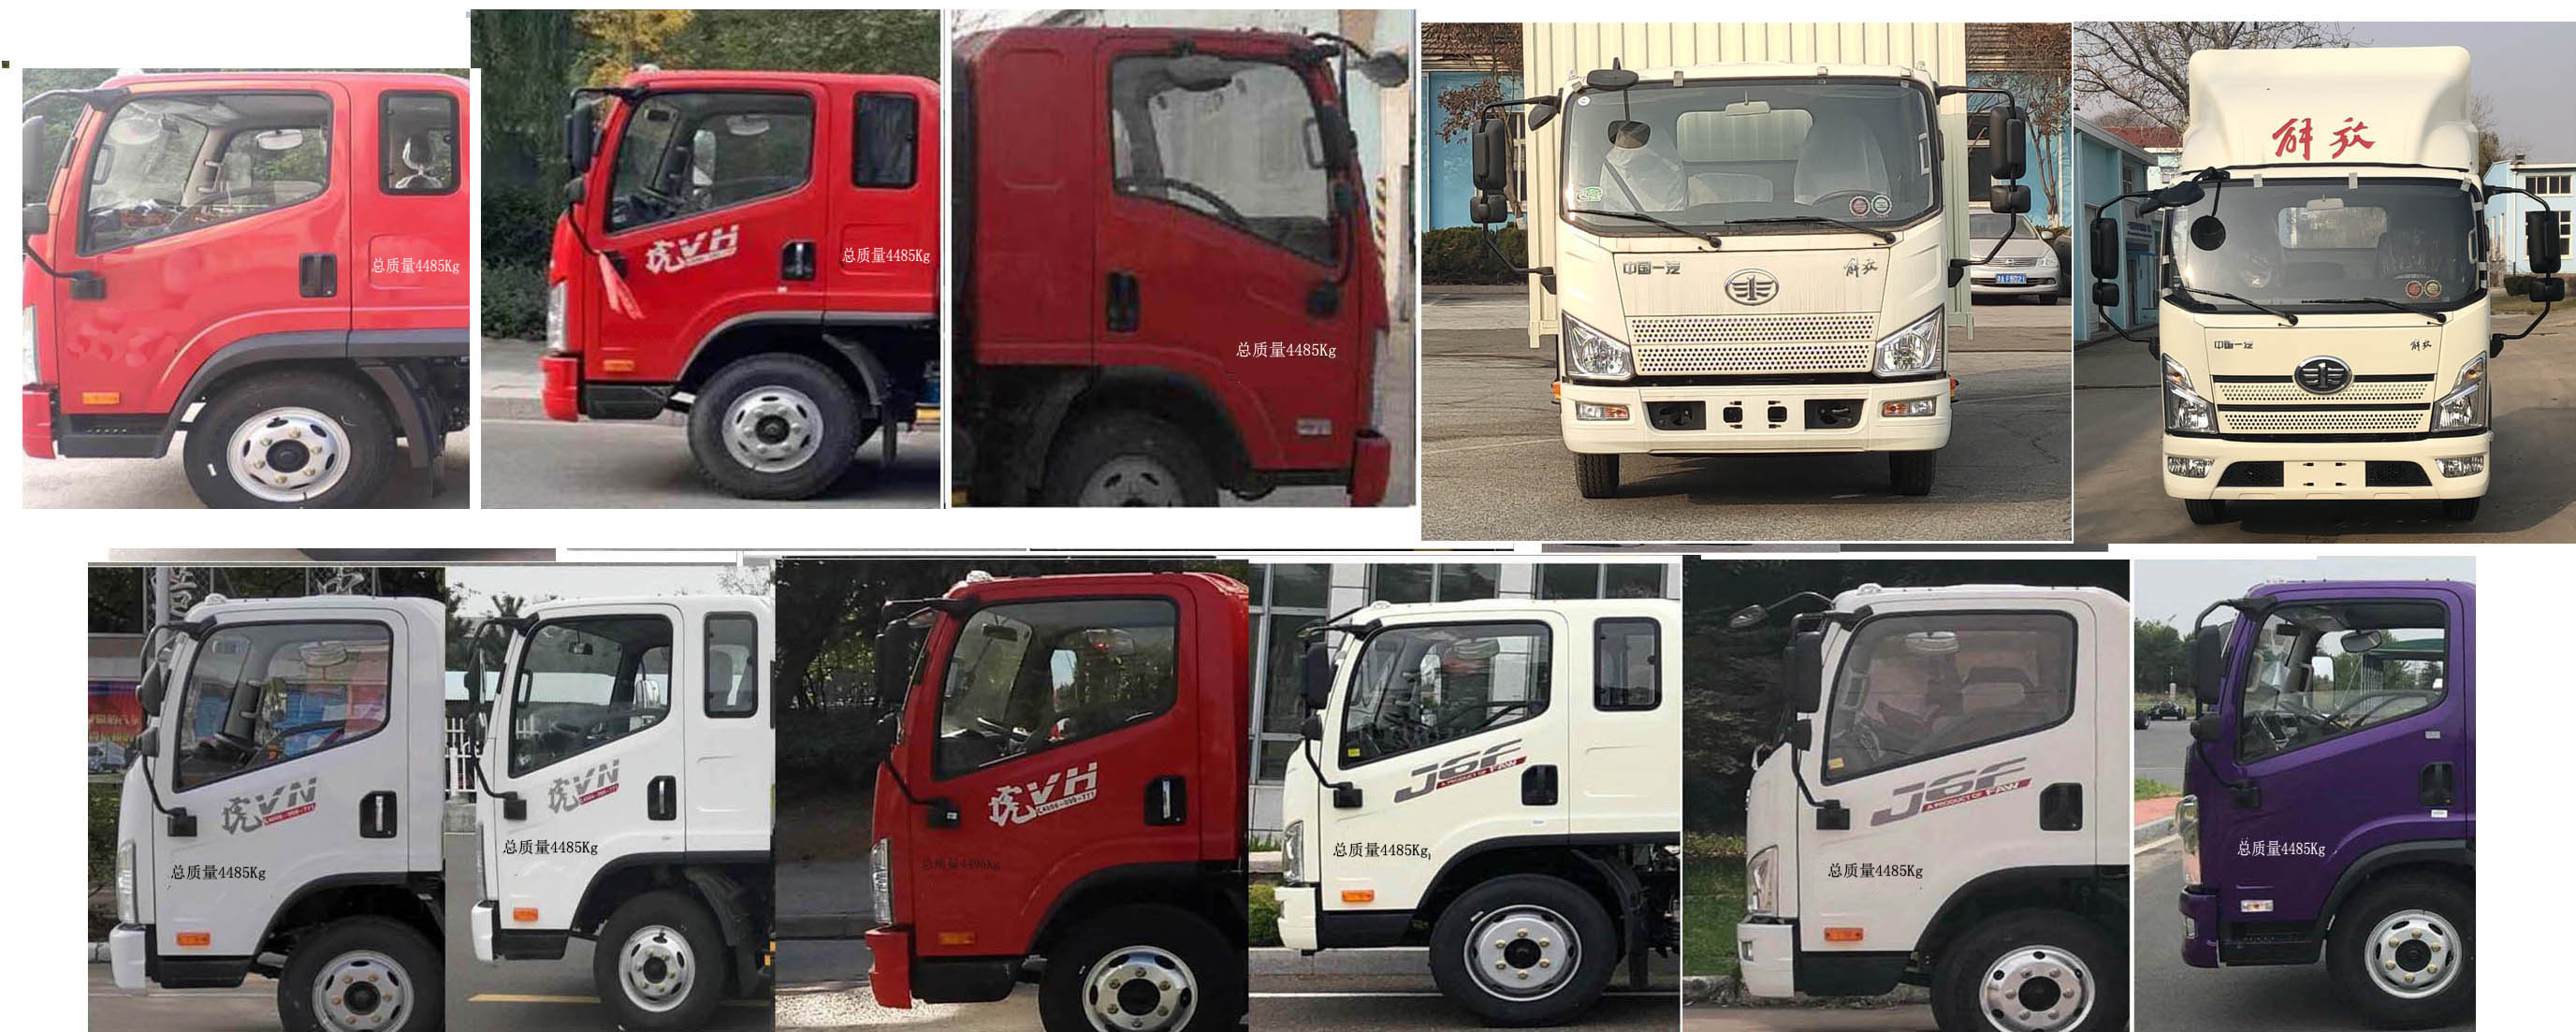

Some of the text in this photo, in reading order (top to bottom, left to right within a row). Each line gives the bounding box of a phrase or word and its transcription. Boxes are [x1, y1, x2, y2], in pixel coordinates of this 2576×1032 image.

[2272, 117, 2376, 161] 解放
[1623, 261, 1681, 275] 中国一汽
